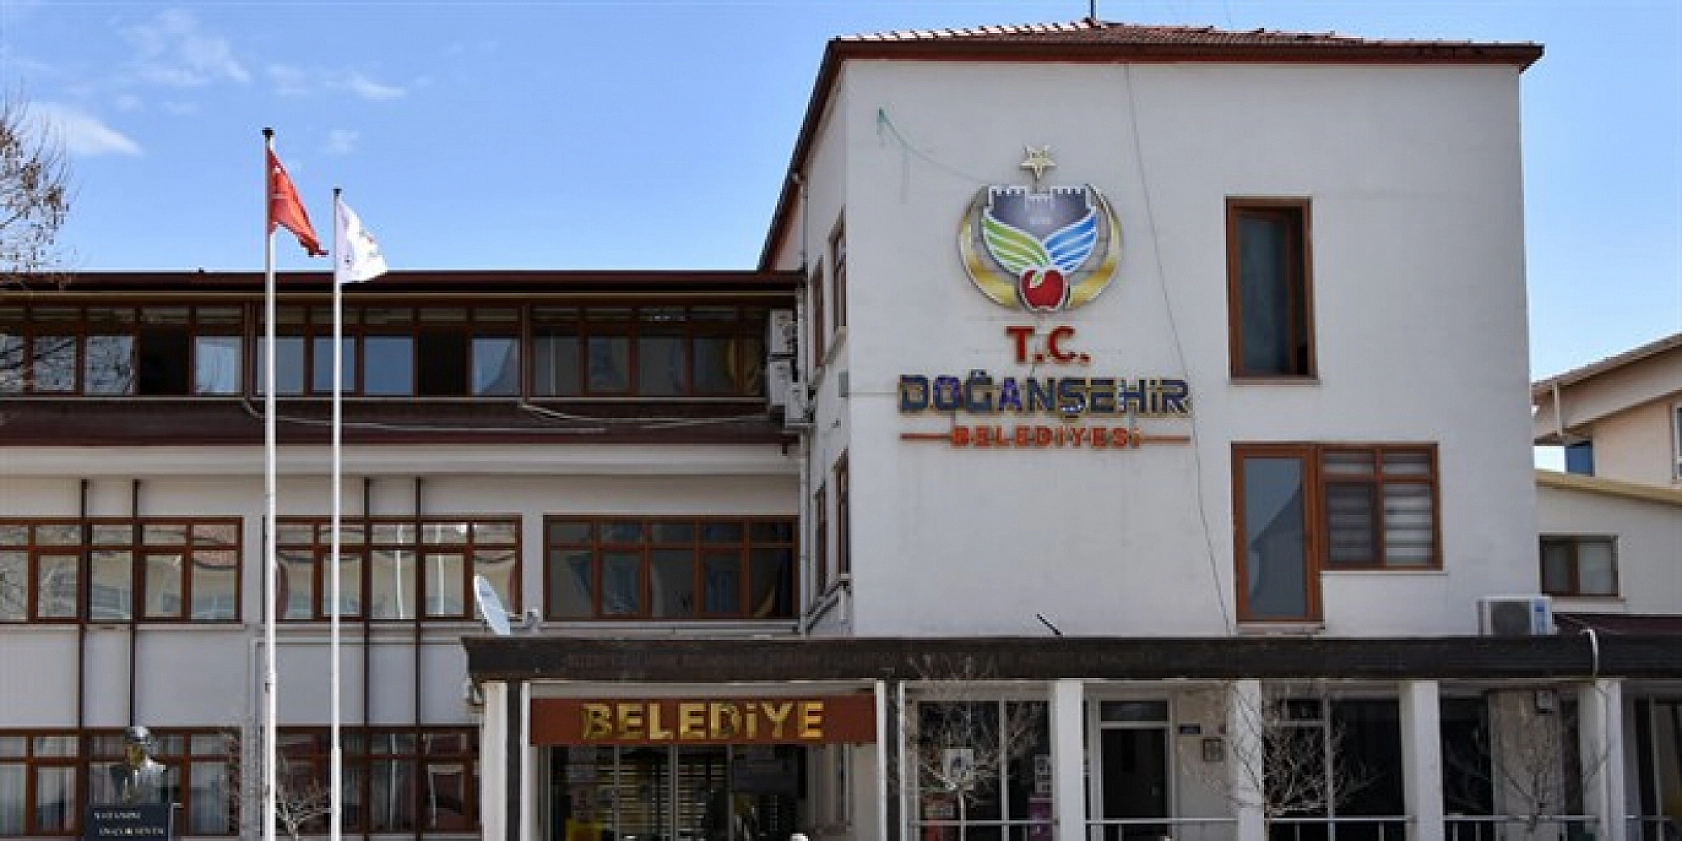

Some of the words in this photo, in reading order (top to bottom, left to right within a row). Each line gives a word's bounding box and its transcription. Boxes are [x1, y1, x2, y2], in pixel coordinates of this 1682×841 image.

[1005, 325, 1091, 363] T.C.
[898, 370, 1191, 421] DOĞANŞEHİR
[582, 702, 824, 740] BELEDİYE
